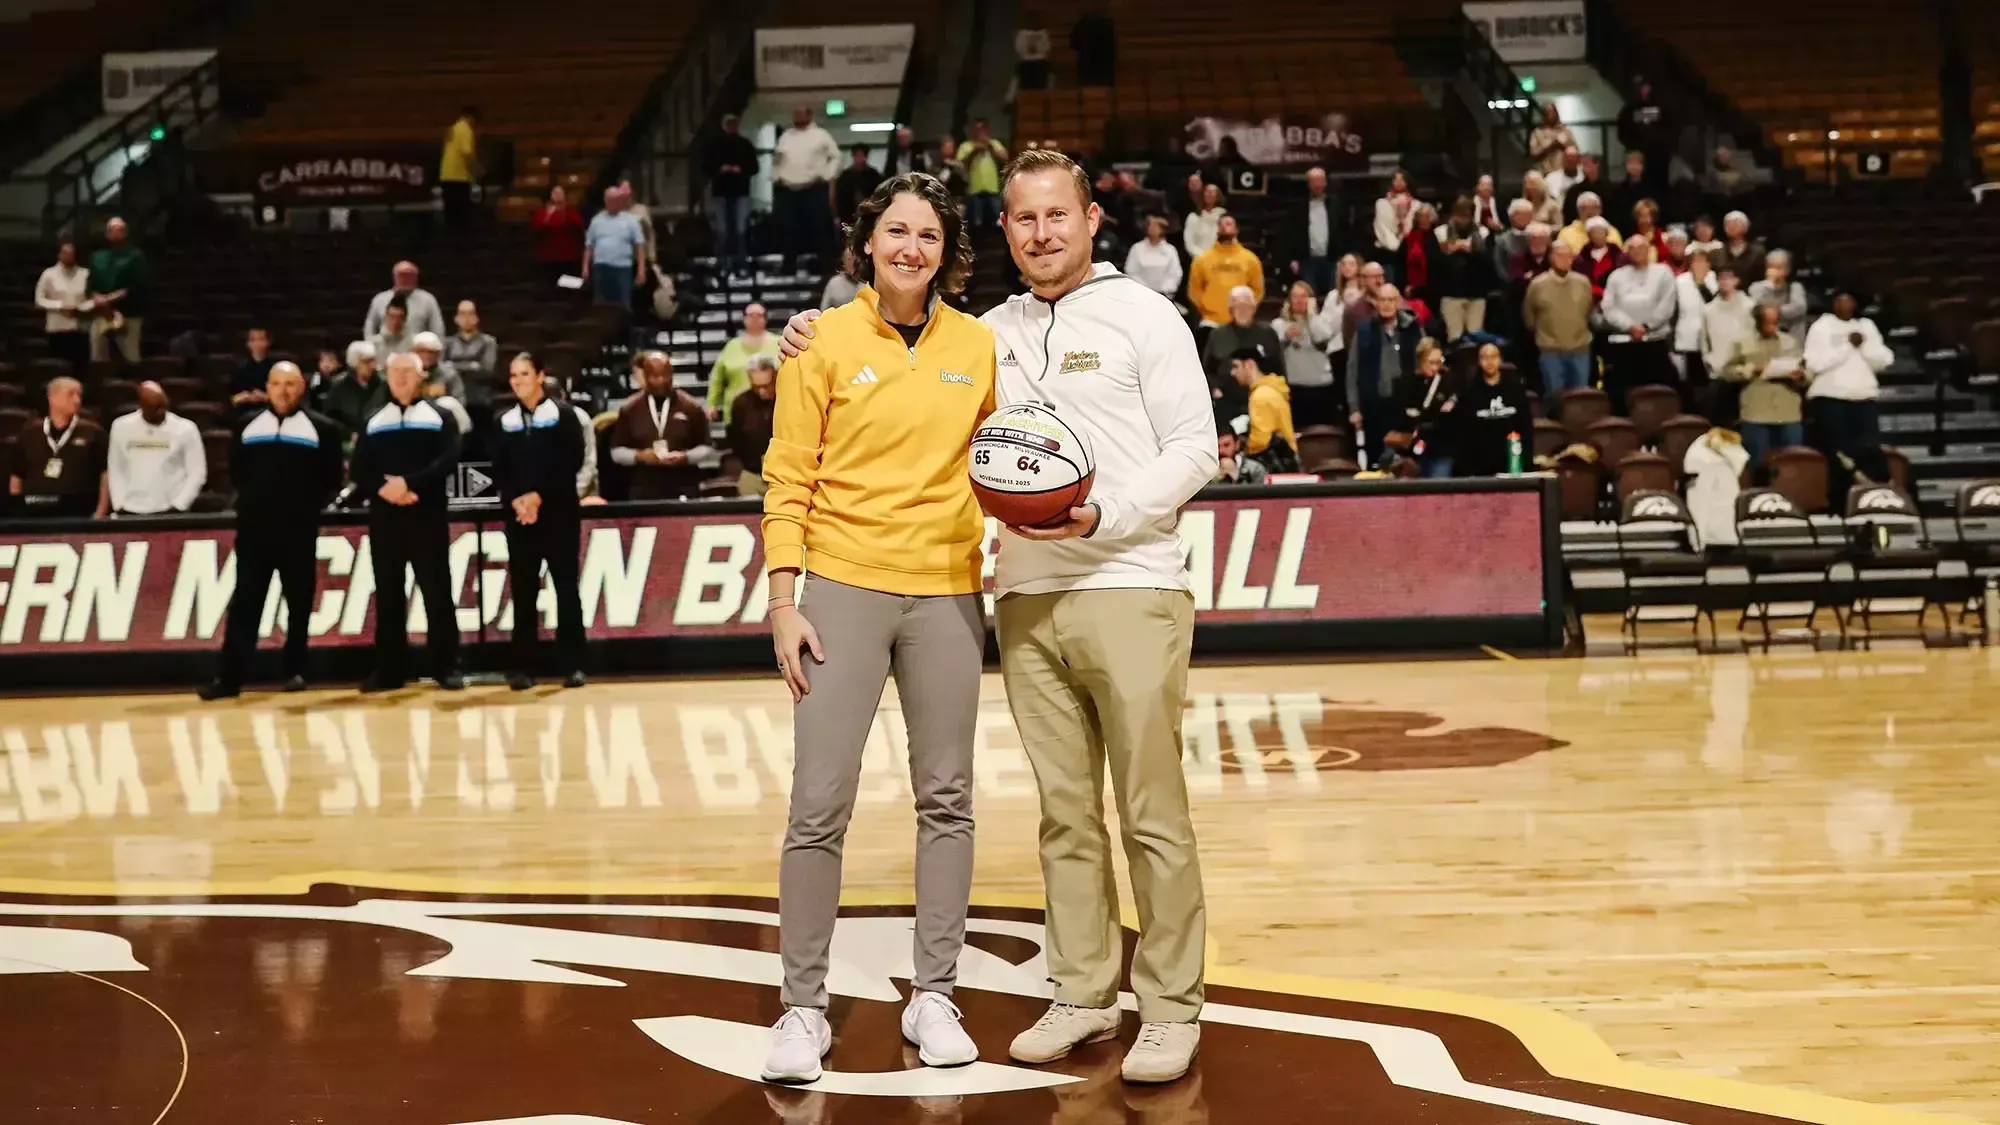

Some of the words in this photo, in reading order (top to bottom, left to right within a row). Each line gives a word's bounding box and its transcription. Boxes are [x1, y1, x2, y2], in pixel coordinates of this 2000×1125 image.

[975, 450, 990, 465] 65
[1014, 446, 1051, 461] MILWAUKEE
[1017, 455, 1041, 475] 64
[979, 474, 1007, 484] NOVEMBER
[0, 541, 149, 643] RN
